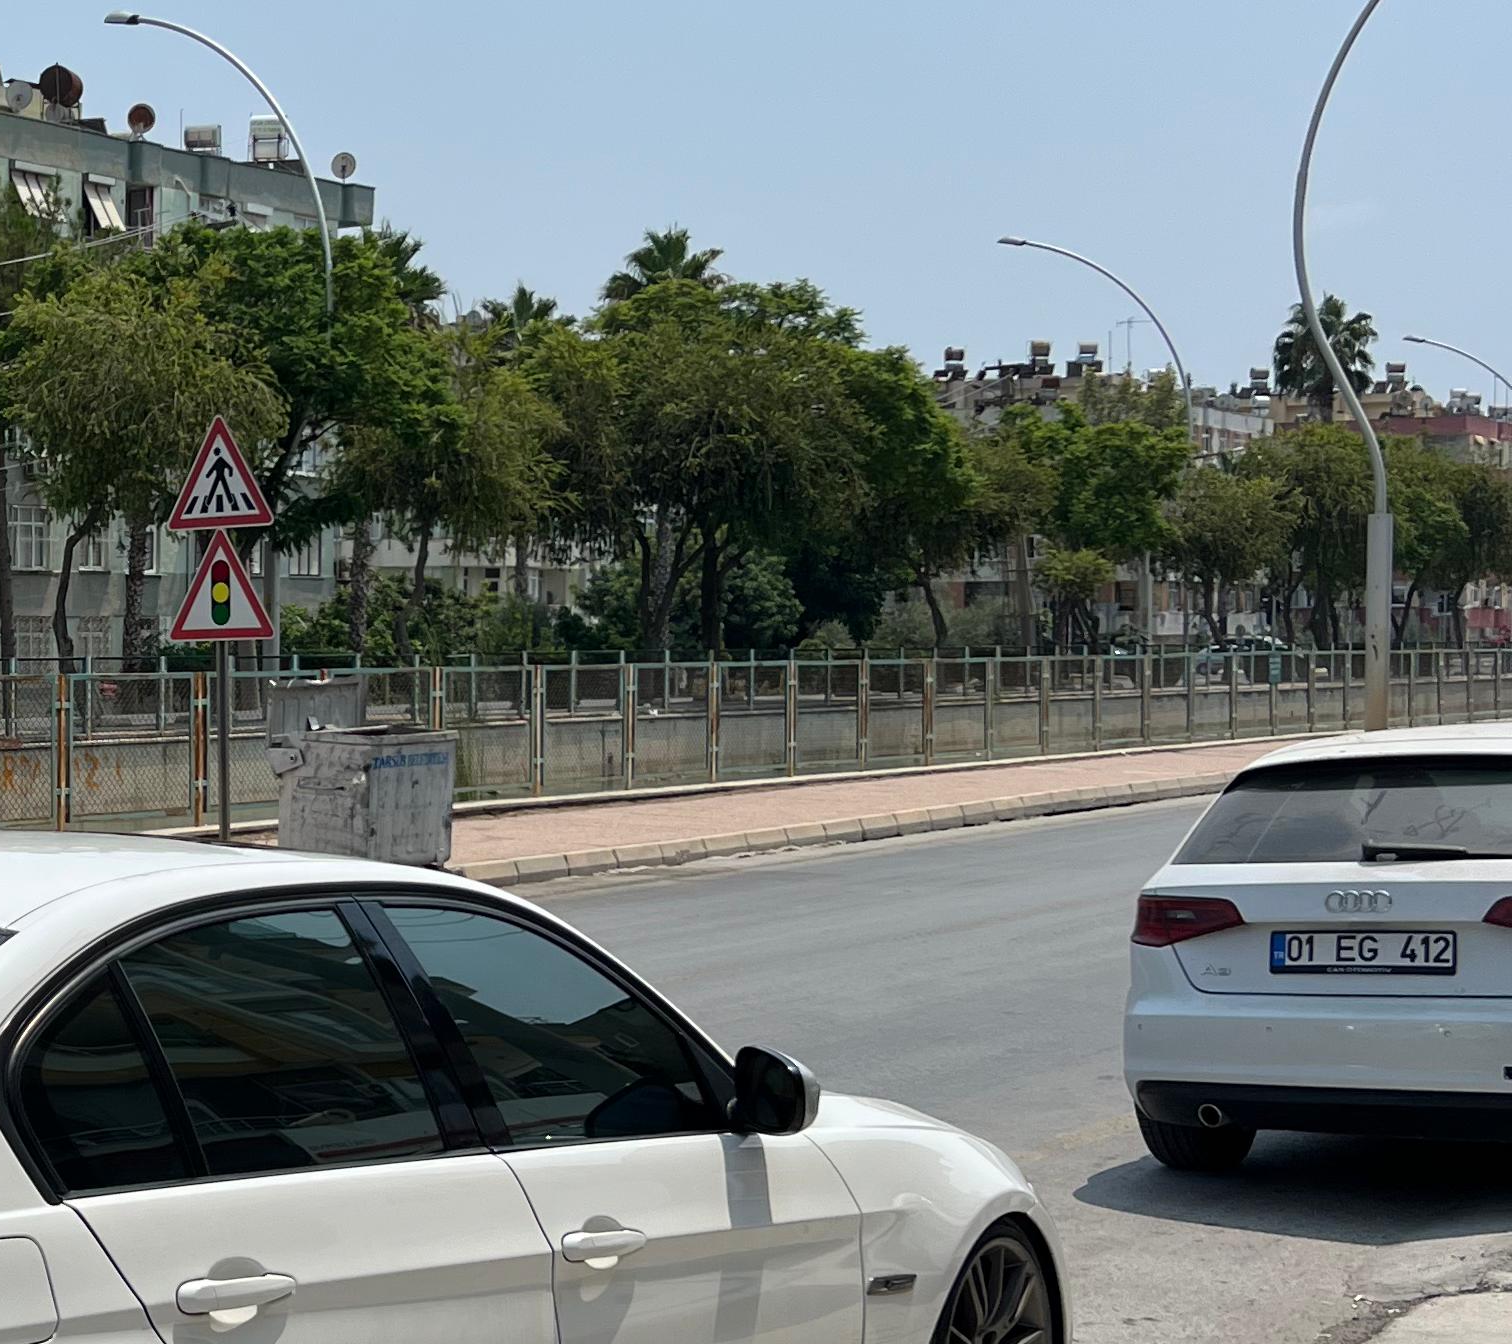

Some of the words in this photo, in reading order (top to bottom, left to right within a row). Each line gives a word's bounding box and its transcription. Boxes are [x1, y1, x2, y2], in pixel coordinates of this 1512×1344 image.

[1287, 935, 1314, 962] 01
[1335, 935, 1379, 962] EG
[1399, 935, 1451, 963] 412
